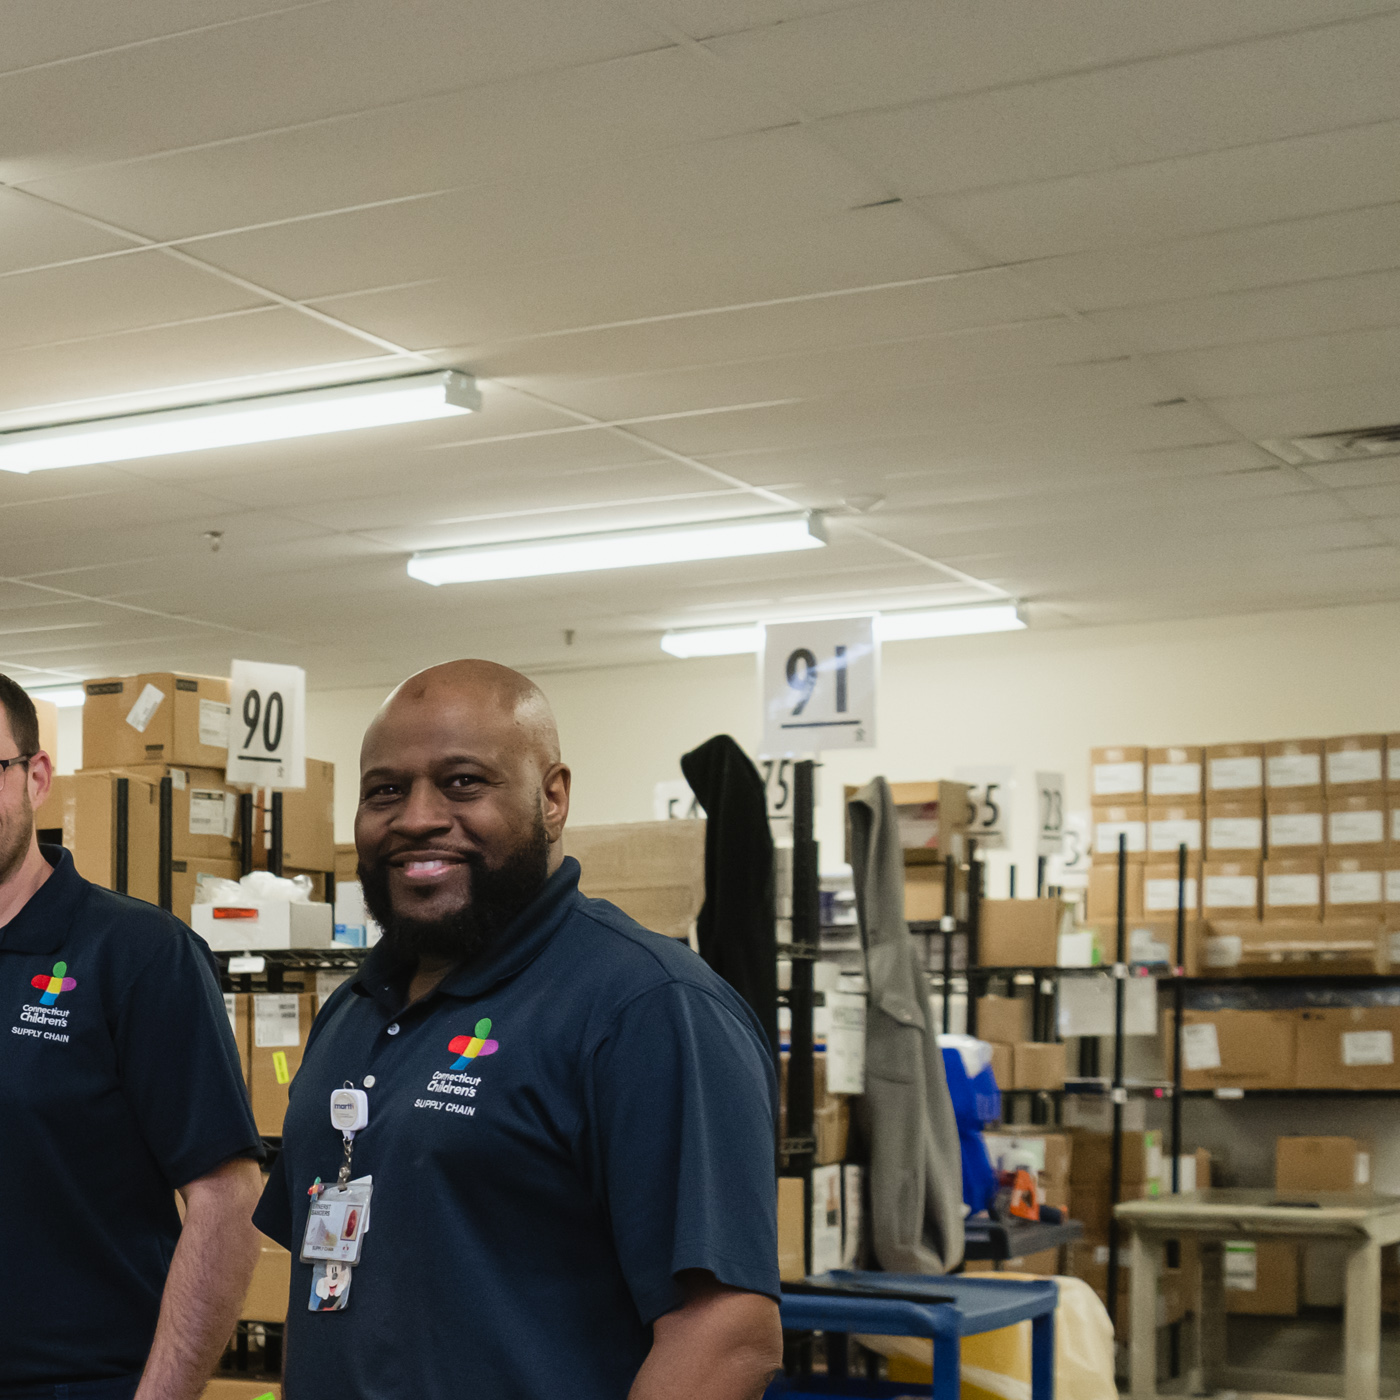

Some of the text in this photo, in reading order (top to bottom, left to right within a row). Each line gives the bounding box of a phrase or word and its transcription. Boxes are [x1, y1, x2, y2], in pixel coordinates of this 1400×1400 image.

[784, 645, 848, 715] 91
[243, 689, 283, 752] 90
[20, 1011, 68, 1027] Children's
[22, 1004, 70, 1017] Connecticut
[11, 1026, 70, 1043] SUPPLY CHAIN
[432, 1070, 482, 1086] Connecticut
[426, 1079, 477, 1098] Children's
[414, 1098, 476, 1116] SUPPLY CHAIN
